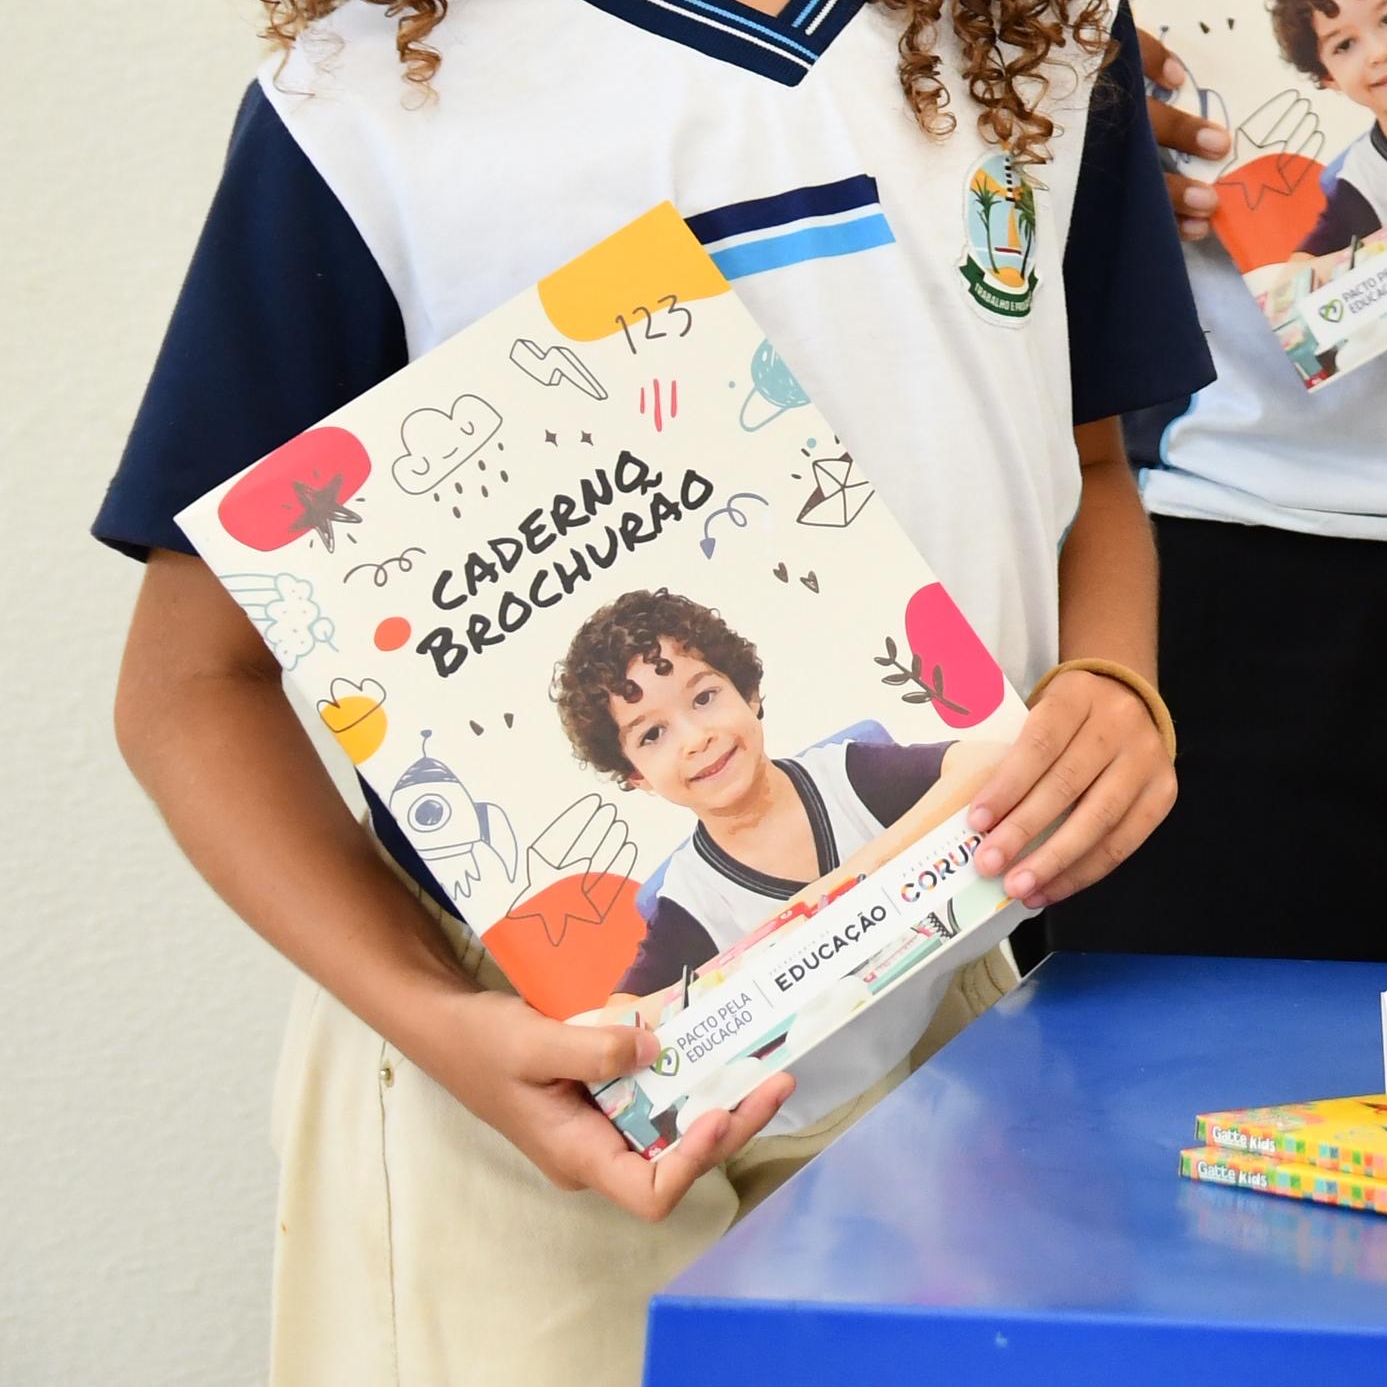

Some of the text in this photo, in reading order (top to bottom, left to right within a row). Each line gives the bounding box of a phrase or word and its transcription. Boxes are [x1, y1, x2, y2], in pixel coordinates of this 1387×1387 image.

[615, 294, 692, 355] 123
[431, 449, 656, 611] CADERNO
[773, 904, 887, 993] EDUCAÇÃO
[676, 992, 753, 1052] PACTO PELA
[685, 1009, 754, 1065] EDUCAÇÃO
[1212, 1125, 1276, 1153] Gatte Kids
[1198, 1160, 1268, 1188] Gatte Kids
